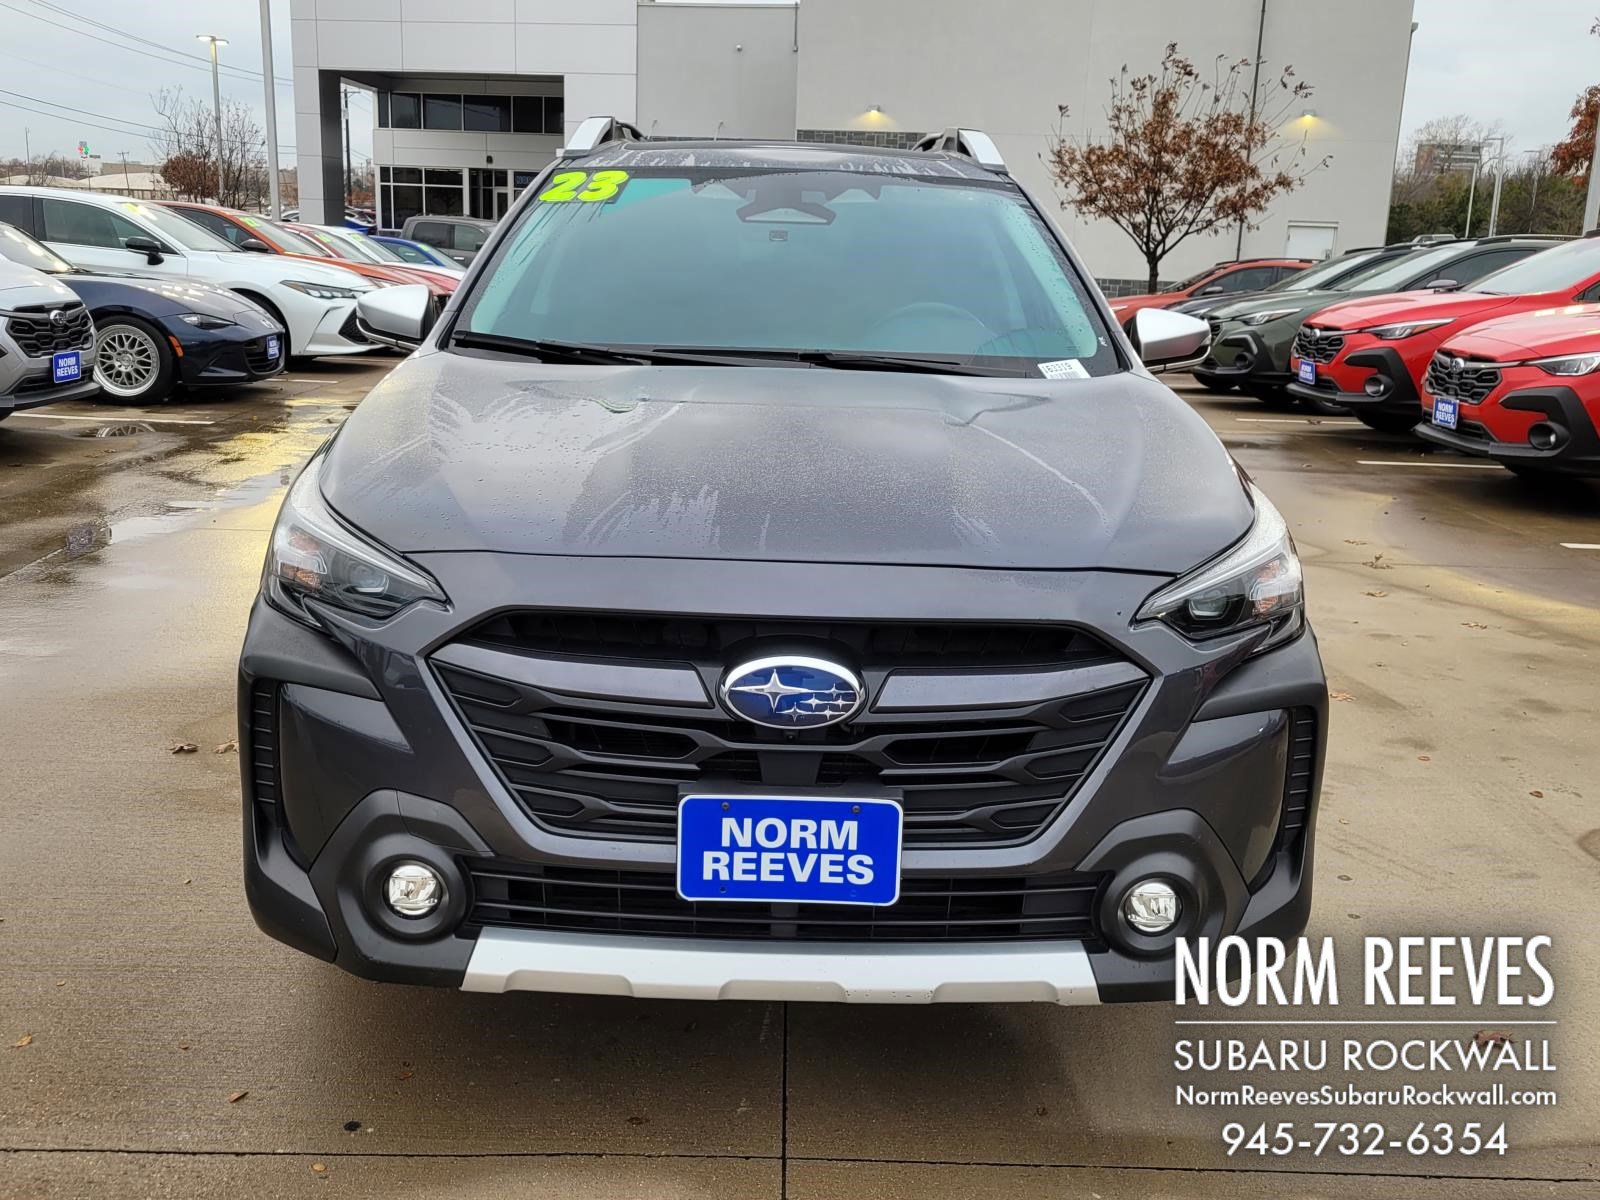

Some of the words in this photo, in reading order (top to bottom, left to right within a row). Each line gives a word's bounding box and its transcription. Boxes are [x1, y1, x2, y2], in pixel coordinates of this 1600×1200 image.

[539, 170, 629, 202] 23
[58, 356, 76, 367] NORM
[56, 365, 78, 377] REEVES
[1437, 402, 1454, 413] NORM
[1435, 410, 1455, 422] REEVES
[721, 817, 858, 850] NORM
[702, 851, 874, 885] REEVES
